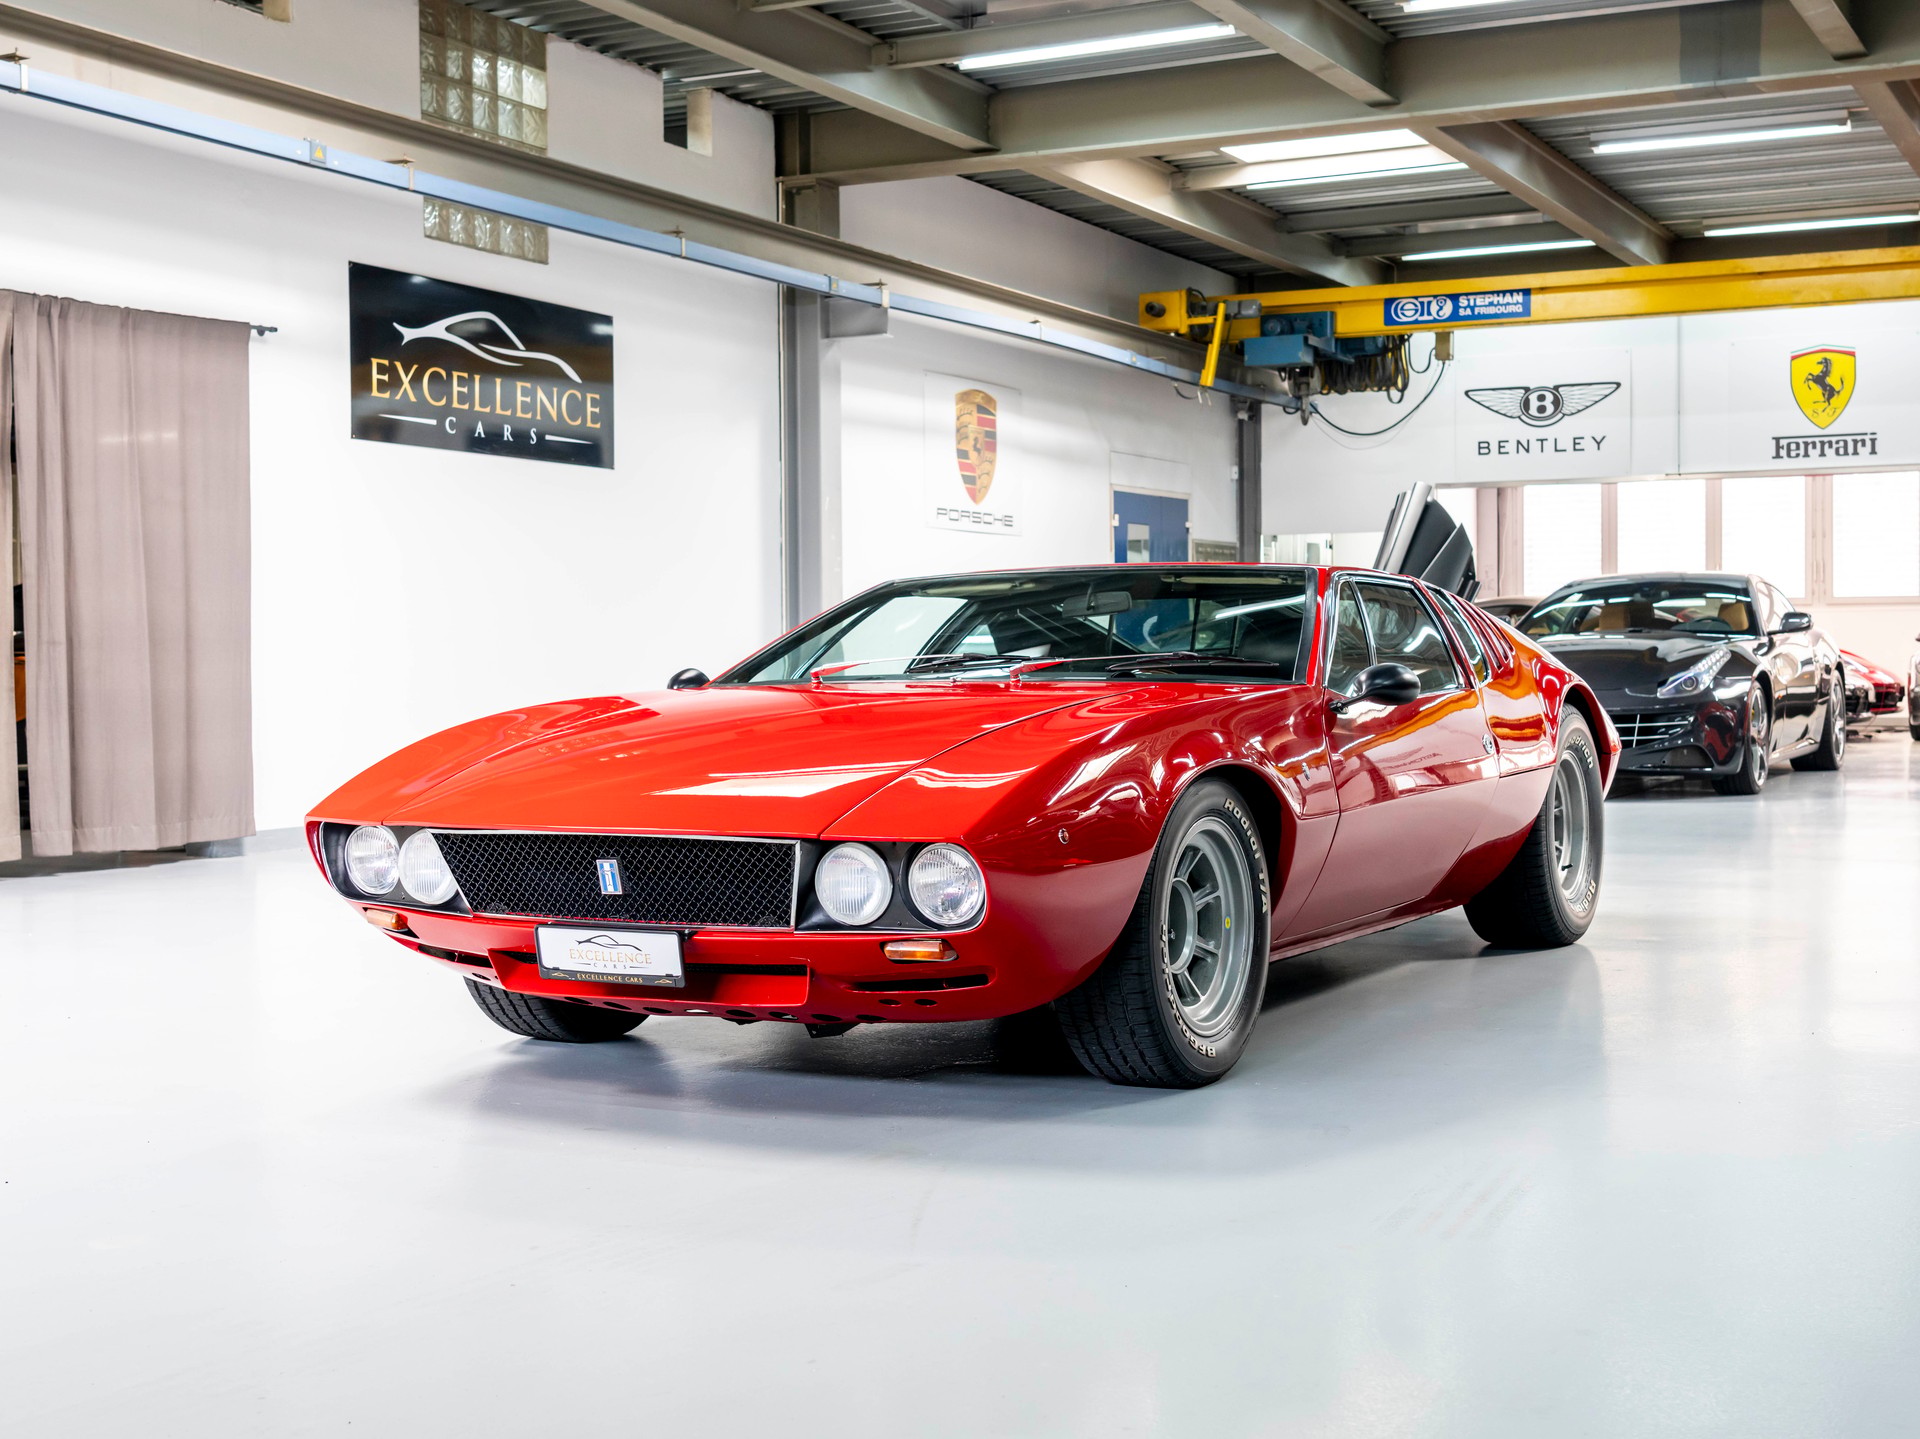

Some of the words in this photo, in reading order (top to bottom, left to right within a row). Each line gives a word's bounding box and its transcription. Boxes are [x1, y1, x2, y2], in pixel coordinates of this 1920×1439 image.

[1458, 292, 1523, 307] STEPHAN
[1458, 308, 1472, 316] SA
[1474, 304, 1523, 315] FRIBOURG
[370, 357, 602, 429] EXCELLENCE
[445, 416, 538, 445] CARS
[1477, 436, 1607, 456] BENTLEY
[1771, 432, 1878, 459] Ferrari
[936, 507, 1014, 528] PORSCHE
[569, 948, 652, 965] EXCELLENCE
[576, 973, 623, 983] EXCELLENCE
